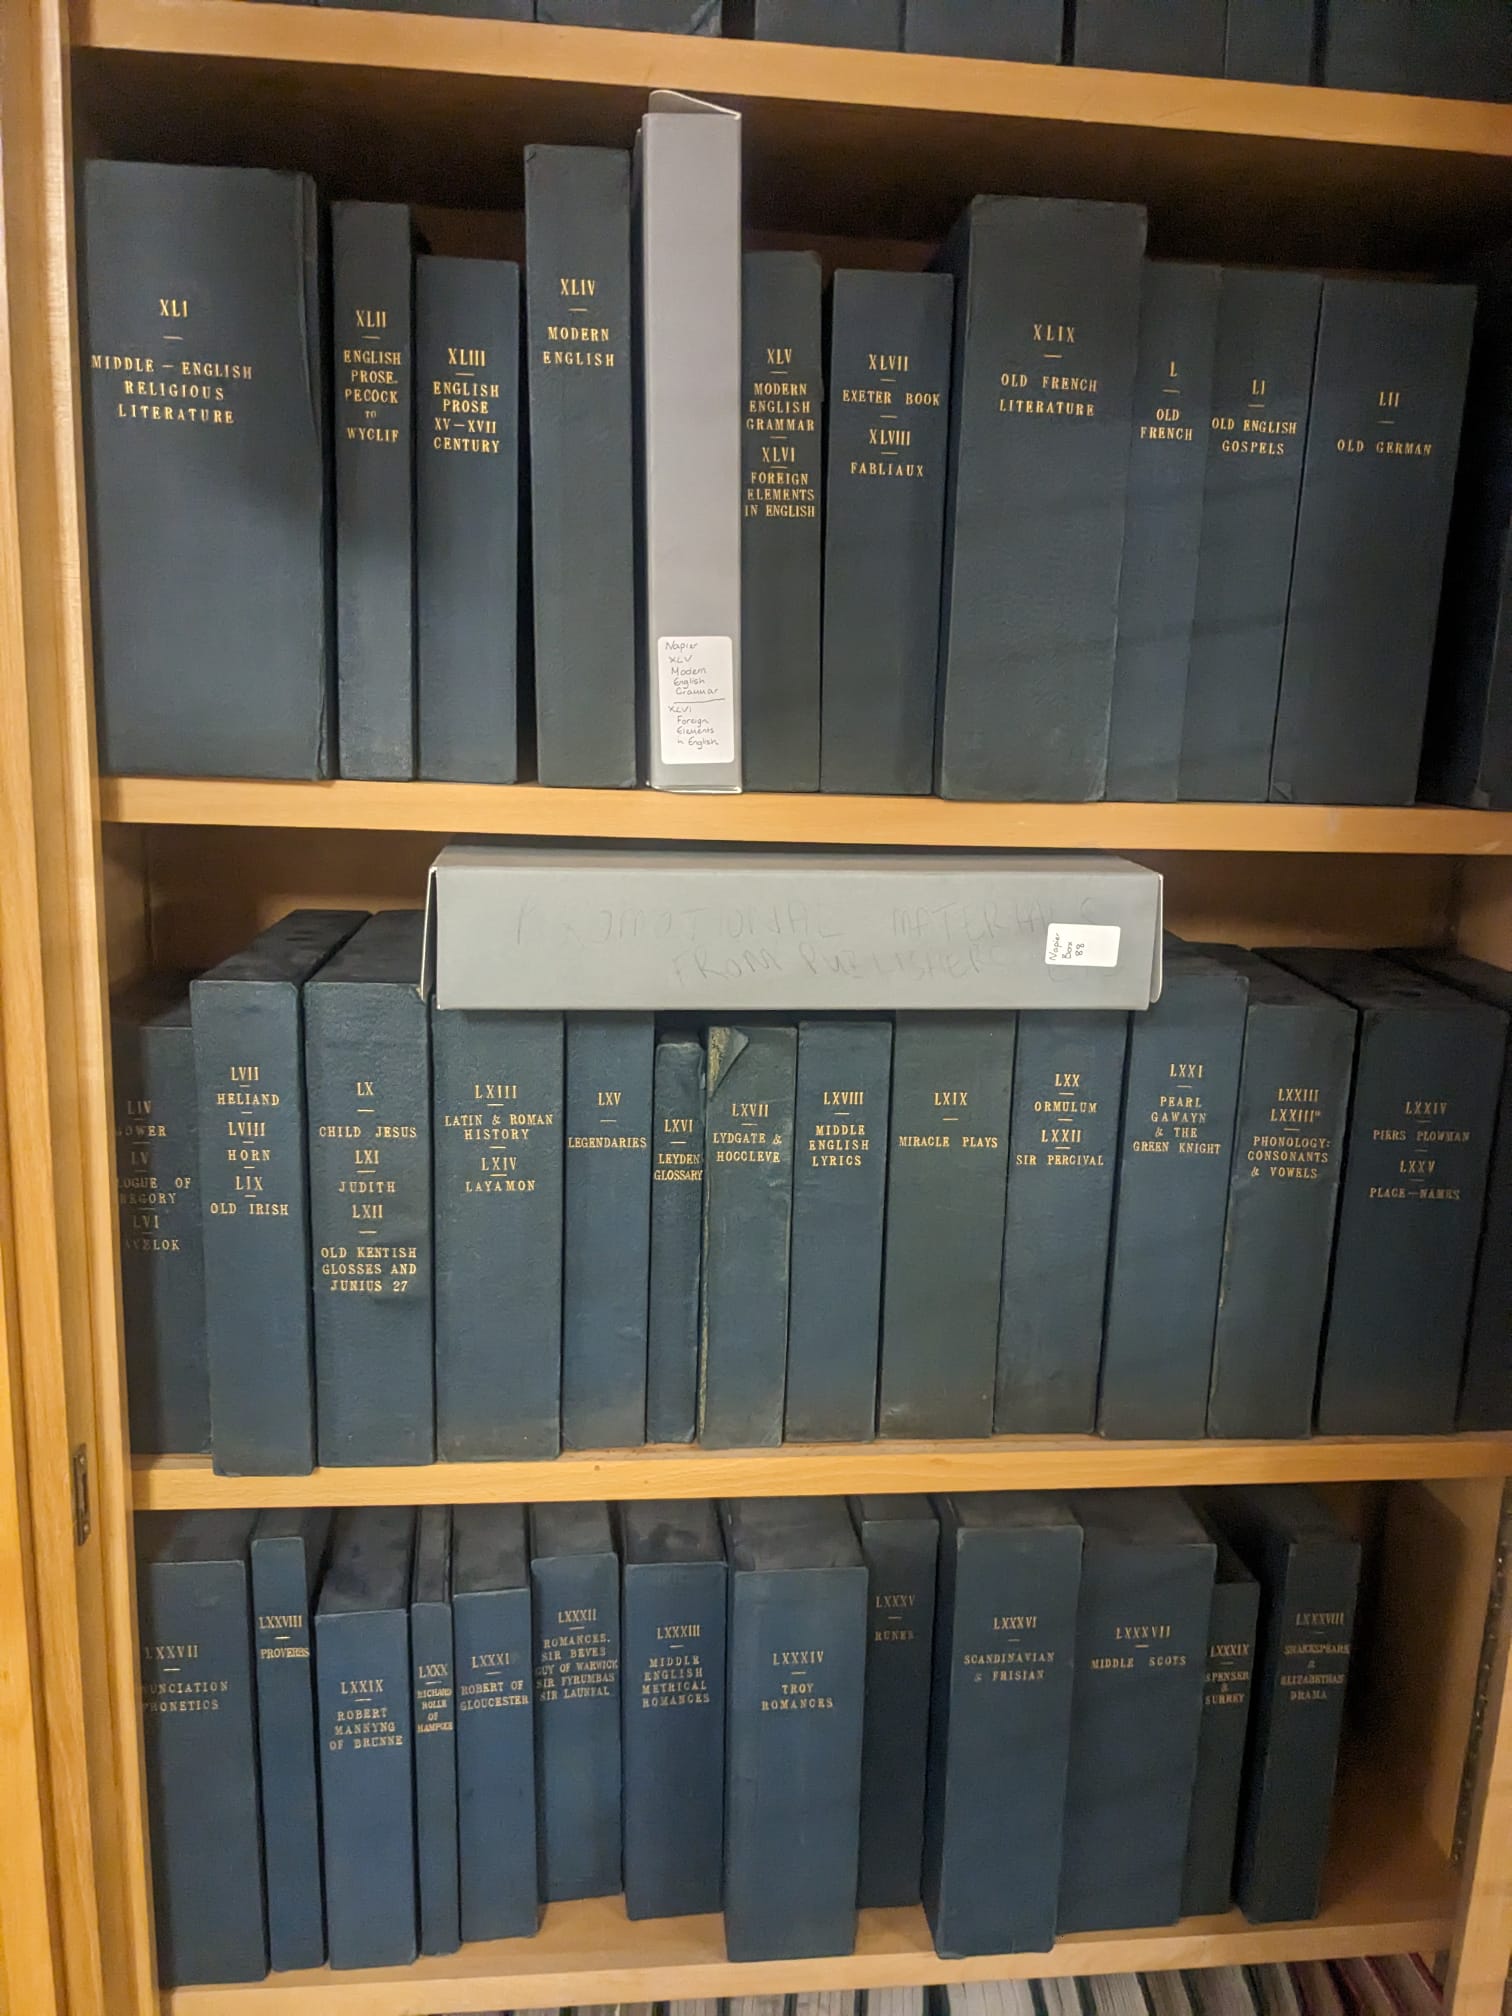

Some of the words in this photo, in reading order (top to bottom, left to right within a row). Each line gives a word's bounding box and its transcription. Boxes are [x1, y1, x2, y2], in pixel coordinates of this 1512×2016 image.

[560, 278, 595, 296] XLIV
[160, 299, 188, 317] XLI
[356, 310, 386, 328] XLII
[548, 326, 609, 342] MODERN
[1034, 324, 1075, 343] XLIX
[344, 350, 401, 365] ENGLISH
[448, 348, 486, 366] XLIII
[543, 351, 614, 367] ENGLISH
[768, 349, 791, 364] XLV
[869, 354, 909, 371] XLVII
[91, 355, 154, 372] MIDDLE
[182, 361, 252, 379] ENGLISH
[1170, 361, 1177, 377] L
[433, 381, 499, 397] ENGLISH
[754, 383, 806, 396] MODERN
[1001, 373, 1027, 387] OLD
[1042, 375, 1097, 392] FRENCH
[1252, 379, 1265, 395] LI
[124, 380, 224, 401] RELIGIOUS
[345, 389, 398, 403] PECOCK
[843, 390, 891, 404] EXETER
[906, 393, 940, 406] BOOK
[1379, 391, 1399, 407] LII
[118, 403, 234, 424] LITERATURE
[365, 410, 376, 418] TO
[443, 400, 488, 414] PROSE
[750, 401, 811, 413] ENGLISH
[1000, 399, 1095, 416] LITERATURE
[1156, 409, 1179, 421] OLD
[746, 419, 814, 431] GRAMMAR
[1211, 417, 1234, 430] OLD
[1243, 419, 1296, 434] ENGLISH
[347, 428, 399, 442] WYCLIF
[869, 429, 910, 446] XLVIII
[1140, 426, 1193, 441] FRENCH
[434, 437, 499, 453] CENTURY
[1222, 440, 1285, 455] GOSPELS
[1337, 439, 1364, 452] OLD
[1376, 441, 1432, 456] GERMAN
[763, 447, 795, 463] XLVI
[851, 462, 924, 477] FABLIAUX
[751, 472, 808, 484] FOREIGN
[748, 489, 814, 501] ELEMENTS
[745, 505, 758, 517] IN
[766, 505, 815, 517] ENGLISH
[665, 641, 698, 653] Napier
[674, 678, 705, 689] English
[677, 715, 709, 727] Foreign
[677, 726, 714, 735] Elements
[231, 1067, 259, 1080] LVII
[1170, 1064, 1203, 1078] LXXI
[1056, 1073, 1080, 1087] LXX
[357, 1082, 374, 1096] LX
[475, 1085, 517, 1099] LXIII
[1278, 1088, 1319, 1103] LXXIII
[217, 1094, 279, 1105] HELIAND
[598, 1092, 621, 1106] LXV
[824, 1091, 864, 1105] LXVIII
[934, 1092, 968, 1106] LXIX
[1160, 1097, 1201, 1108] PEARL
[732, 1104, 768, 1117] LXVII
[1034, 1101, 1098, 1113] ORMULUM
[1405, 1101, 1447, 1115] LXXIV
[444, 1115, 482, 1126] LATIN
[492, 1115, 500, 1125] &
[510, 1114, 552, 1125] ROMAN
[1151, 1112, 1206, 1123] GAWAYN
[228, 1122, 265, 1136] LVIII
[319, 1126, 361, 1137] CHILD
[375, 1127, 416, 1138] JESUS
[664, 1119, 693, 1133] LXVI
[816, 1125, 865, 1136] MIDDLE
[1155, 1128, 1163, 1137] &
[1174, 1127, 1197, 1138] THE
[465, 1130, 529, 1140] HISTORY
[713, 1133, 765, 1144] LYDGATE
[773, 1135, 782, 1145] &
[900, 1136, 950, 1147] MIRACLE
[962, 1137, 998, 1148] PLAYS
[1041, 1129, 1081, 1143] LXXII
[1373, 1129, 1407, 1141] PIERS
[1416, 1130, 1470, 1141] PLOWMAN
[568, 1137, 647, 1148] LEGENDARIES
[809, 1139, 869, 1151] ENGLISH
[1133, 1142, 1169, 1152] GREEN
[1179, 1142, 1221, 1155] KNIGHT
[228, 1150, 270, 1160] HORN
[355, 1150, 379, 1164] LXI
[658, 1154, 700, 1165] LEYDEN
[716, 1152, 780, 1163] HOCCLEVE
[812, 1155, 861, 1167] LYRICS
[1016, 1155, 1037, 1165] SIR
[1048, 1155, 1104, 1166] PERCIVAL
[1248, 1151, 1328, 1163] CONSONANTS
[481, 1157, 517, 1171] LXIV
[1400, 1160, 1435, 1173] LXXV
[654, 1170, 702, 1181] GLOSSARY
[1251, 1167, 1259, 1176] &
[1270, 1167, 1318, 1179] VOWELS
[175, 1177, 191, 1189] OF
[235, 1176, 263, 1190] LIX
[339, 1182, 395, 1193] JUDITH
[466, 1180, 535, 1192] LAYAMON
[210, 1203, 236, 1214] OLD
[250, 1204, 288, 1215] IRISH
[352, 1205, 383, 1218] LXII
[321, 1248, 346, 1258] OLD
[357, 1247, 416, 1258] KENTISH
[322, 1264, 381, 1275] GLOSSES
[390, 1264, 416, 1274] AND
[331, 1280, 382, 1291] JUNIUS
[393, 1280, 408, 1291] 27
[876, 1595, 915, 1608] LXXXV
[259, 1615, 302, 1629] LXXVIII
[558, 1608, 596, 1623] LXXXII
[994, 1616, 1037, 1630] LXXXVI
[657, 1625, 700, 1640] LXXXIII
[1116, 1625, 1171, 1640] LXXXVII
[260, 1648, 309, 1658] PROVERBS
[542, 1649, 561, 1662] SIR
[773, 1651, 824, 1666] LXXXIV
[964, 1652, 1055, 1665] SCANDINAVIAN
[472, 1653, 509, 1669] LXXXI
[560, 1663, 570, 1673] OF
[576, 1659, 618, 1671] WARWICK
[650, 1656, 700, 1668] MIDDLE
[1091, 1658, 1134, 1669] MIDDLE
[1149, 1656, 1187, 1667] SCOTS
[419, 1664, 448, 1678] LXXX
[644, 1668, 703, 1681] ENGLISH
[992, 1670, 1045, 1682] FRISIAN
[340, 1679, 384, 1695] LXXIX
[461, 1682, 503, 1695] ROBERT
[511, 1680, 524, 1690] OF
[642, 1681, 707, 1695] METRICAL
[782, 1683, 814, 1694] TROY
[460, 1695, 528, 1710] GLOUCESTER
[642, 1693, 710, 1708] ROMANCES
[761, 1697, 833, 1711] ROMANCES
[337, 1708, 387, 1721] ROBERT
[329, 1740, 344, 1750] OF
